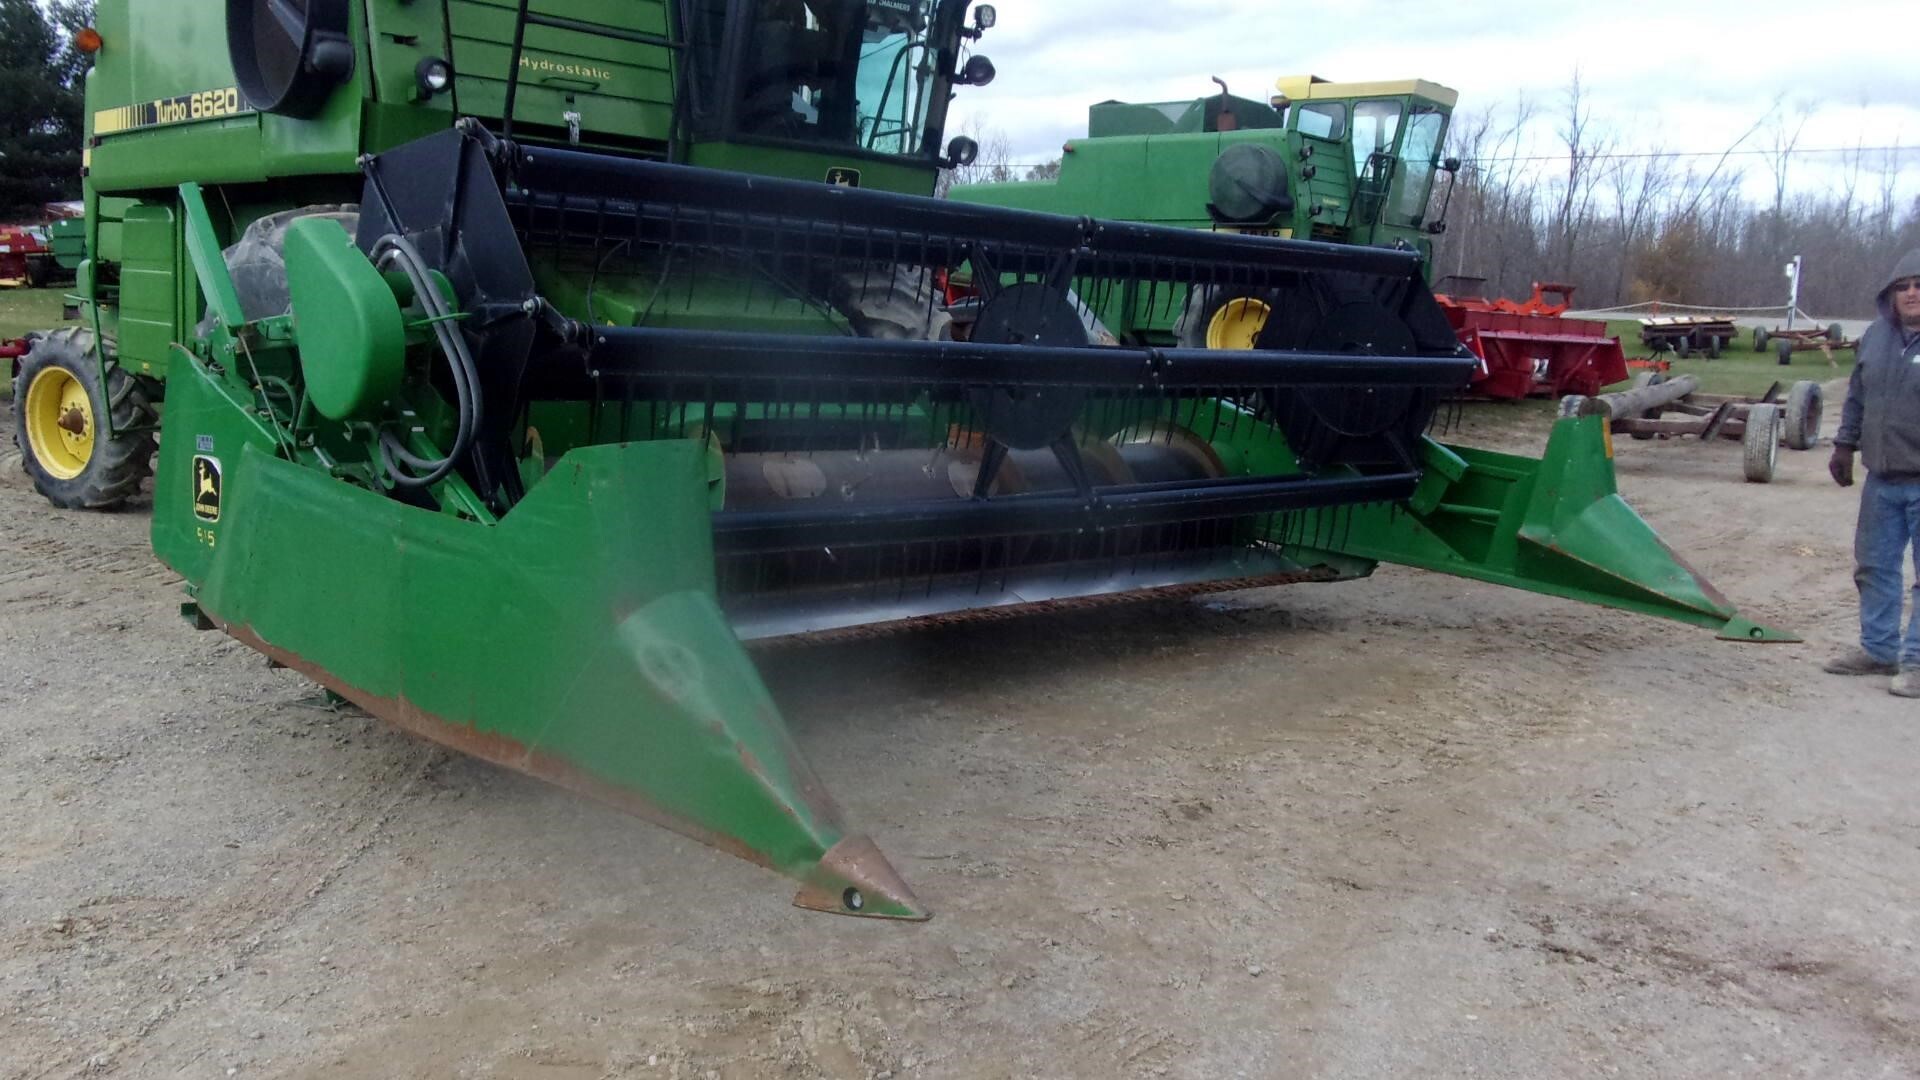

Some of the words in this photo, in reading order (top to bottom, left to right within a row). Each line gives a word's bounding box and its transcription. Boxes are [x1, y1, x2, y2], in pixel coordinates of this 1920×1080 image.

[519, 57, 611, 79] Hydrostatic
[154, 99, 187, 124] Turbo
[191, 88, 238, 118] 6620
